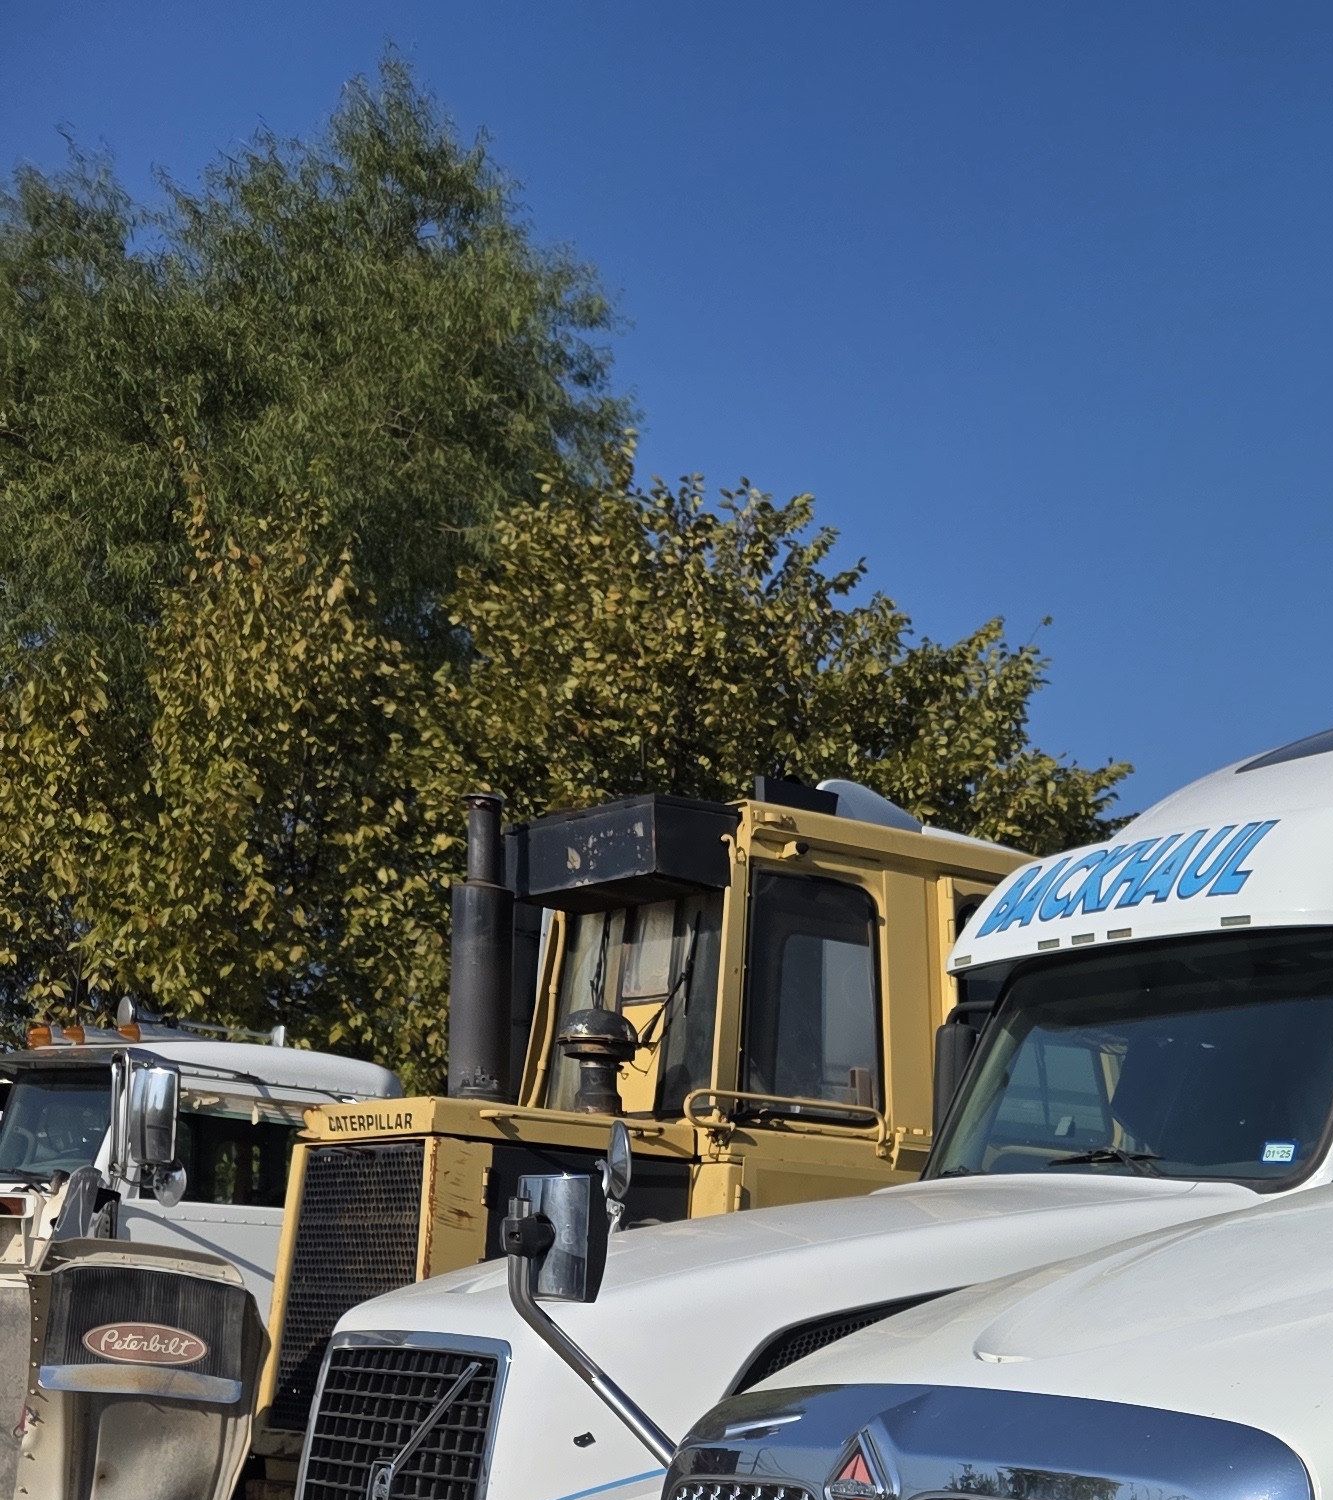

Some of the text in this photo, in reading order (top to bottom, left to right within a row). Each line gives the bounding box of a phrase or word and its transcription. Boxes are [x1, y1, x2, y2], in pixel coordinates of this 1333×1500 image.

[974, 818, 1283, 940] BACKHAUL
[327, 1112, 413, 1133] CATERPILLAR
[100, 1328, 197, 1357] Peterbilt
